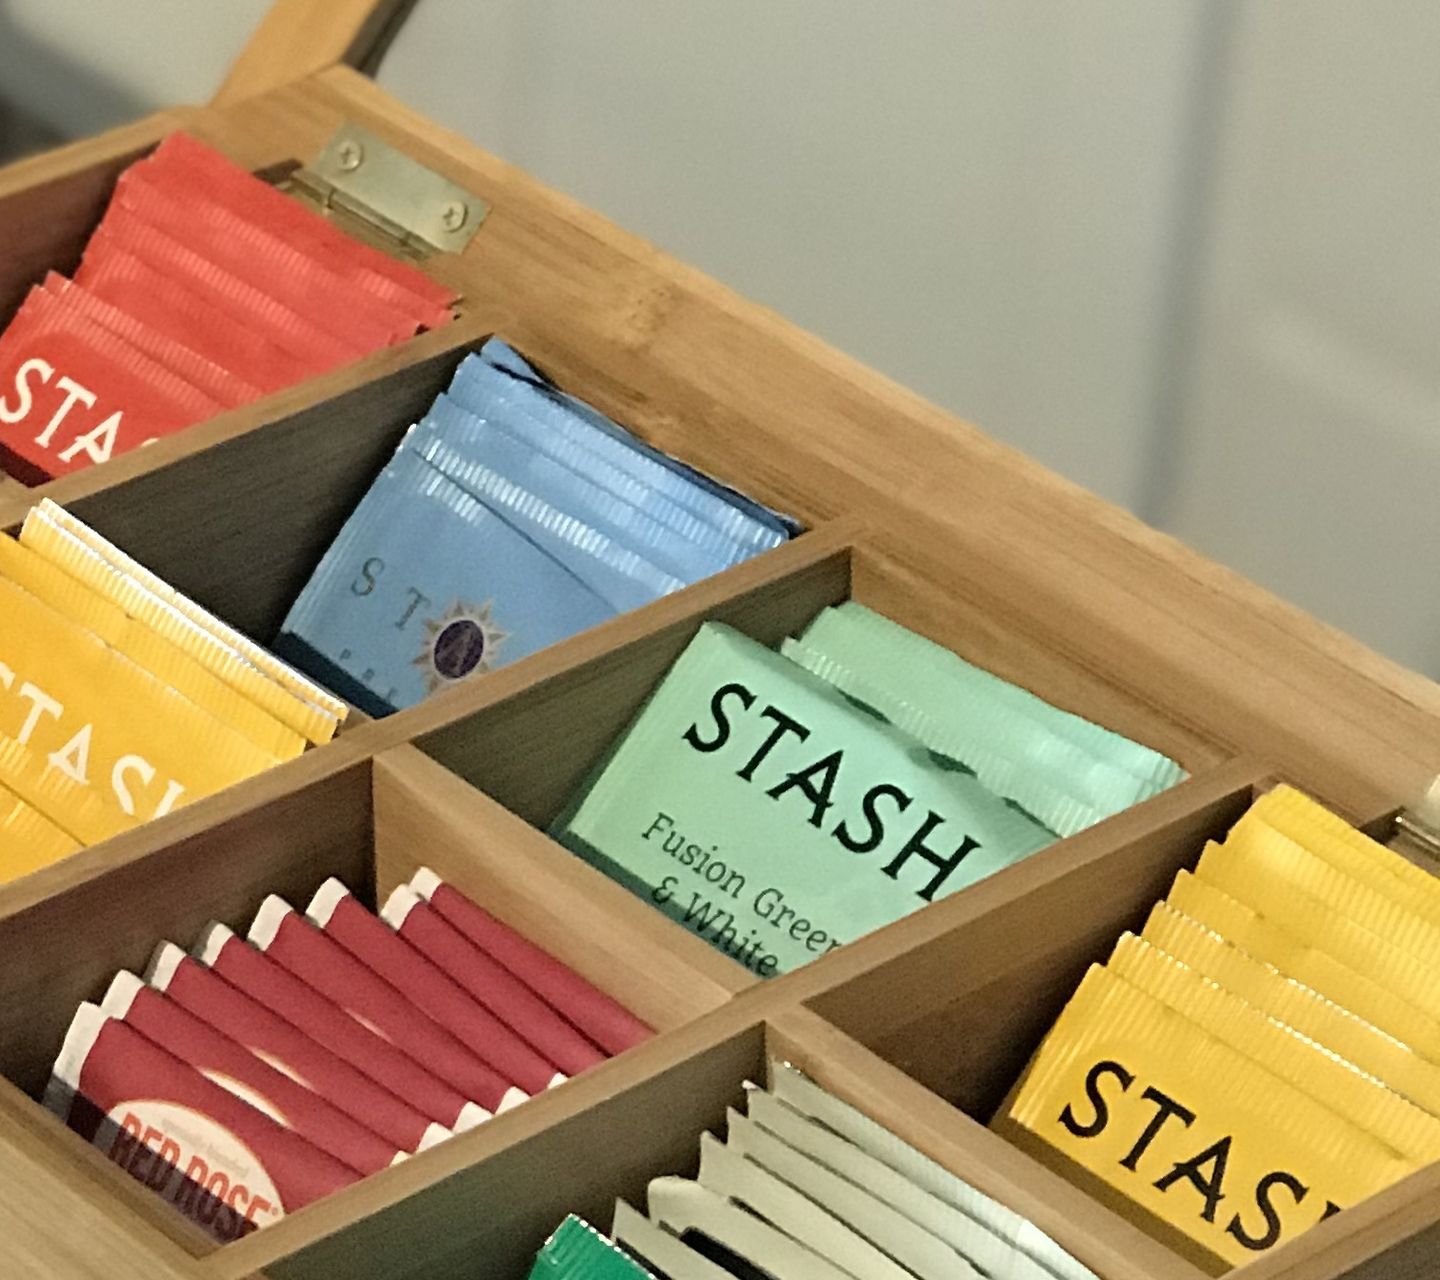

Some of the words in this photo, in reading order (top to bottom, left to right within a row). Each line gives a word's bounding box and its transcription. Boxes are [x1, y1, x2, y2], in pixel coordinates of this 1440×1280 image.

[682, 681, 982, 902] STASH
[641, 811, 747, 899] Fusion
[651, 875, 679, 904] &
[683, 892, 779, 978] White
[108, 1112, 181, 1194] RED
[1057, 1060, 1345, 1251] STAS
